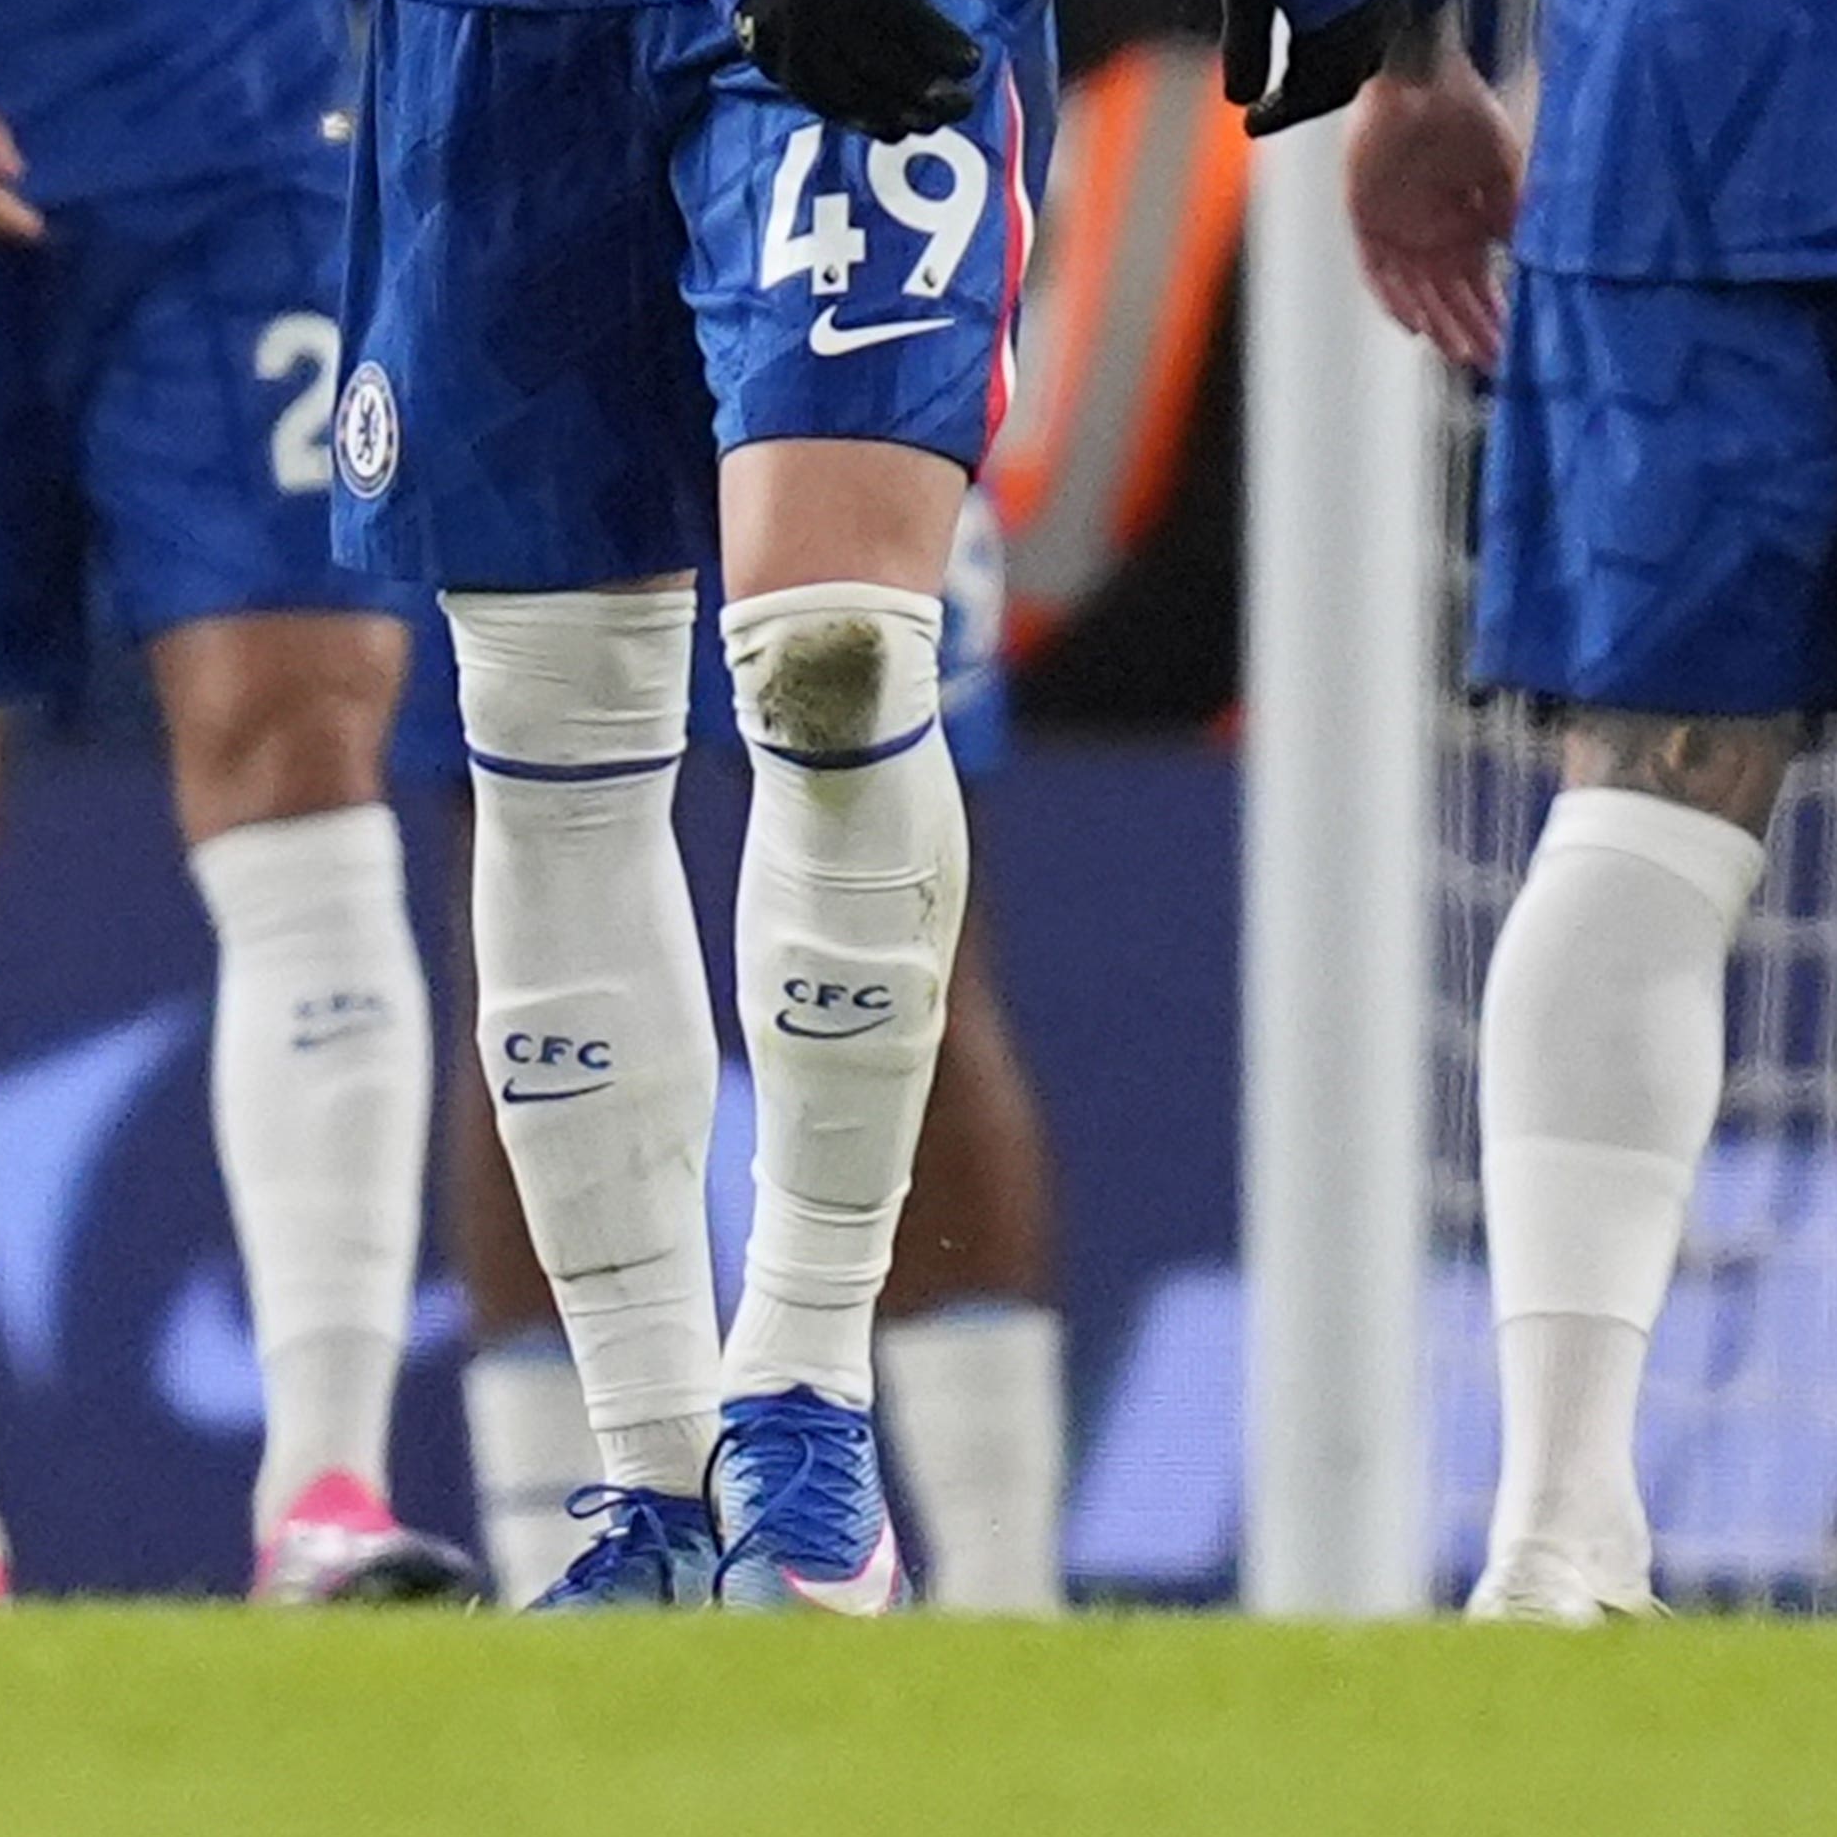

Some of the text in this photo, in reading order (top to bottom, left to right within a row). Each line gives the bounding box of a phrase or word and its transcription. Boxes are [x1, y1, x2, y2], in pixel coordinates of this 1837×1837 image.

[759, 120, 990, 299] 49
[782, 976, 894, 1011] CFC
[504, 1031, 613, 1071] CFC
